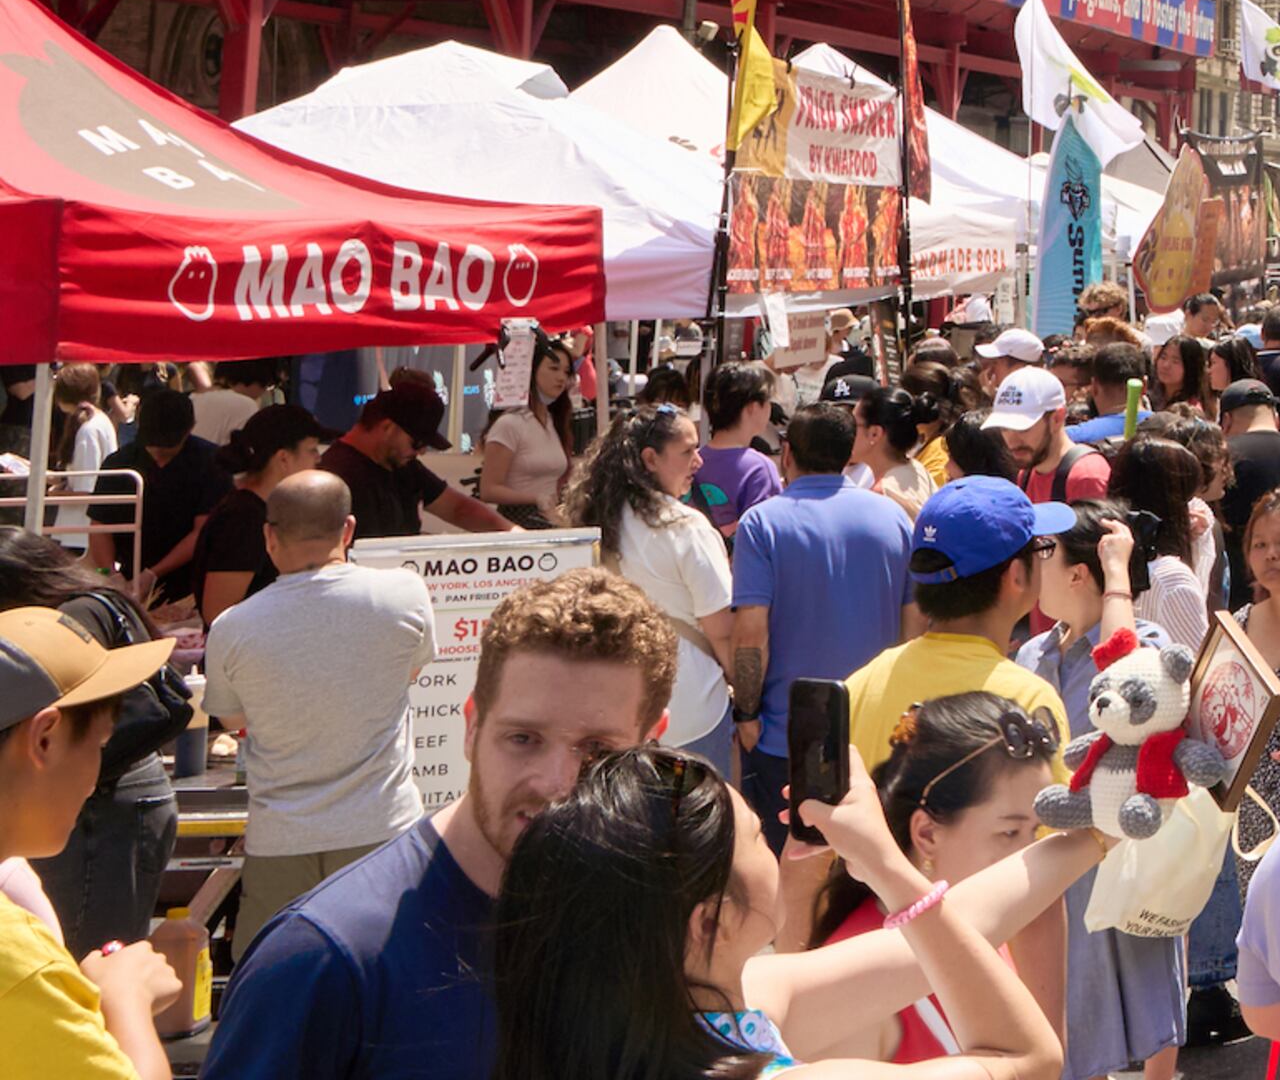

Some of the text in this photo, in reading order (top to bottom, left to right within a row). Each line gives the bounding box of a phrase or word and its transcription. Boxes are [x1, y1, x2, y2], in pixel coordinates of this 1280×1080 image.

[1193, 7, 1215, 43] future
[77, 119, 205, 156] MA
[809, 144, 823, 174] BY
[142, 158, 266, 192] BA
[911, 247, 971, 278] ANDMADE
[1068, 222, 1085, 320] Sum
[234, 239, 495, 321] MAO BAO
[424, 555, 535, 577] MAO BAO
[473, 579, 494, 588] LOS
[495, 577, 540, 588] ANGELE
[445, 594, 468, 603] PAN
[470, 592, 500, 602] FRIED
[453, 616, 489, 641] $1
[438, 645, 480, 656] HOOSE
[410, 703, 461, 718] HICK
[414, 734, 448, 749] EEF
[411, 763, 448, 777] AMB
